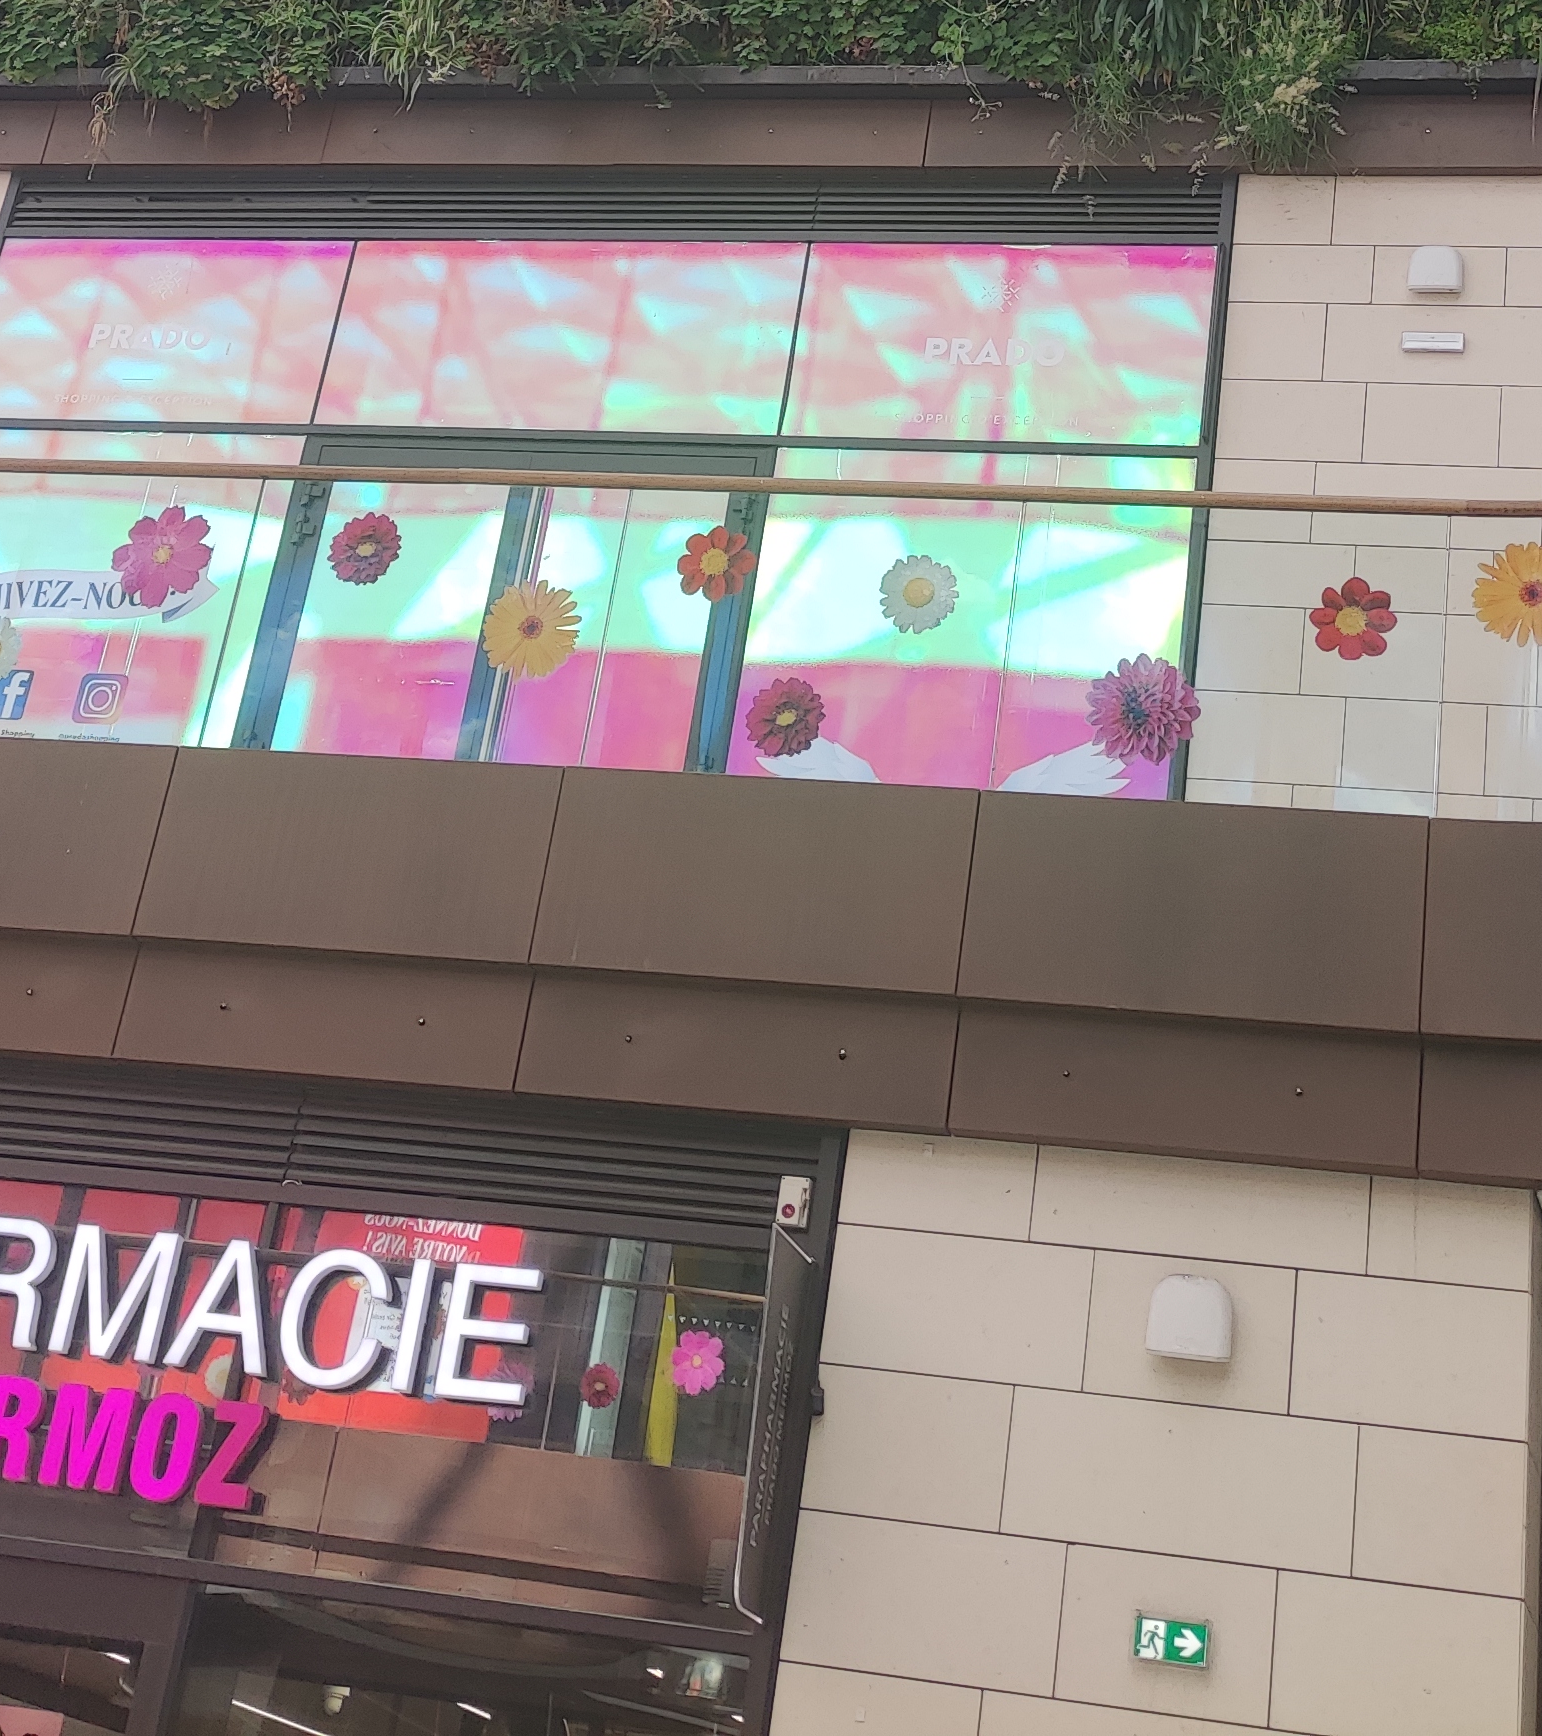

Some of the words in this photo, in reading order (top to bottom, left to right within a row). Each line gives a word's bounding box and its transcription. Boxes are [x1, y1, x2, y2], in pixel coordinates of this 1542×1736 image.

[88, 323, 211, 351] PRADO
[924, 337, 1066, 367] PRADO
[895, 414, 970, 425] SOPPIG
